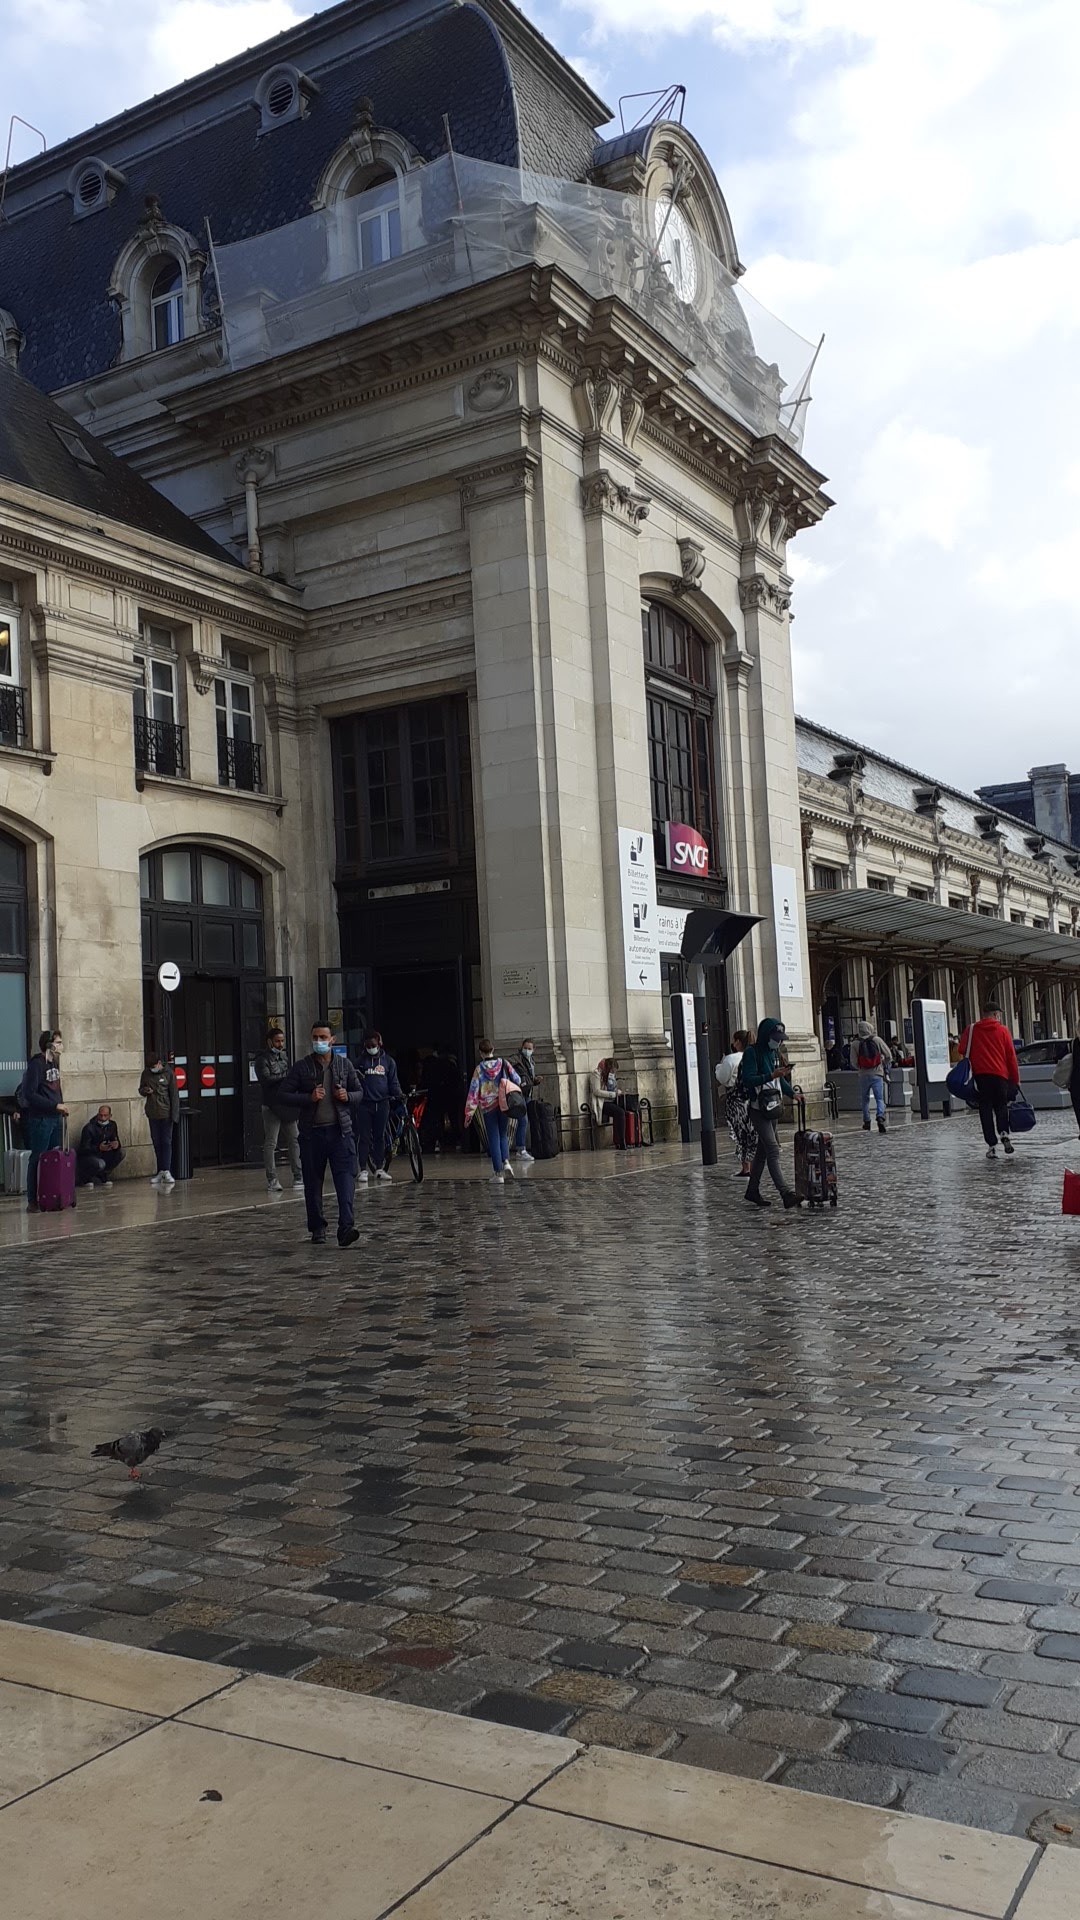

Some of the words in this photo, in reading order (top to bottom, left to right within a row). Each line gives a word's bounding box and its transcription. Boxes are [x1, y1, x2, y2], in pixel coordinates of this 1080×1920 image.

[673, 842, 708, 868] SNCF
[628, 869, 649, 880] Billetterie
[657, 914, 674, 929] rains
[675, 917, 679, 929] à
[628, 945, 657, 955] automatique
